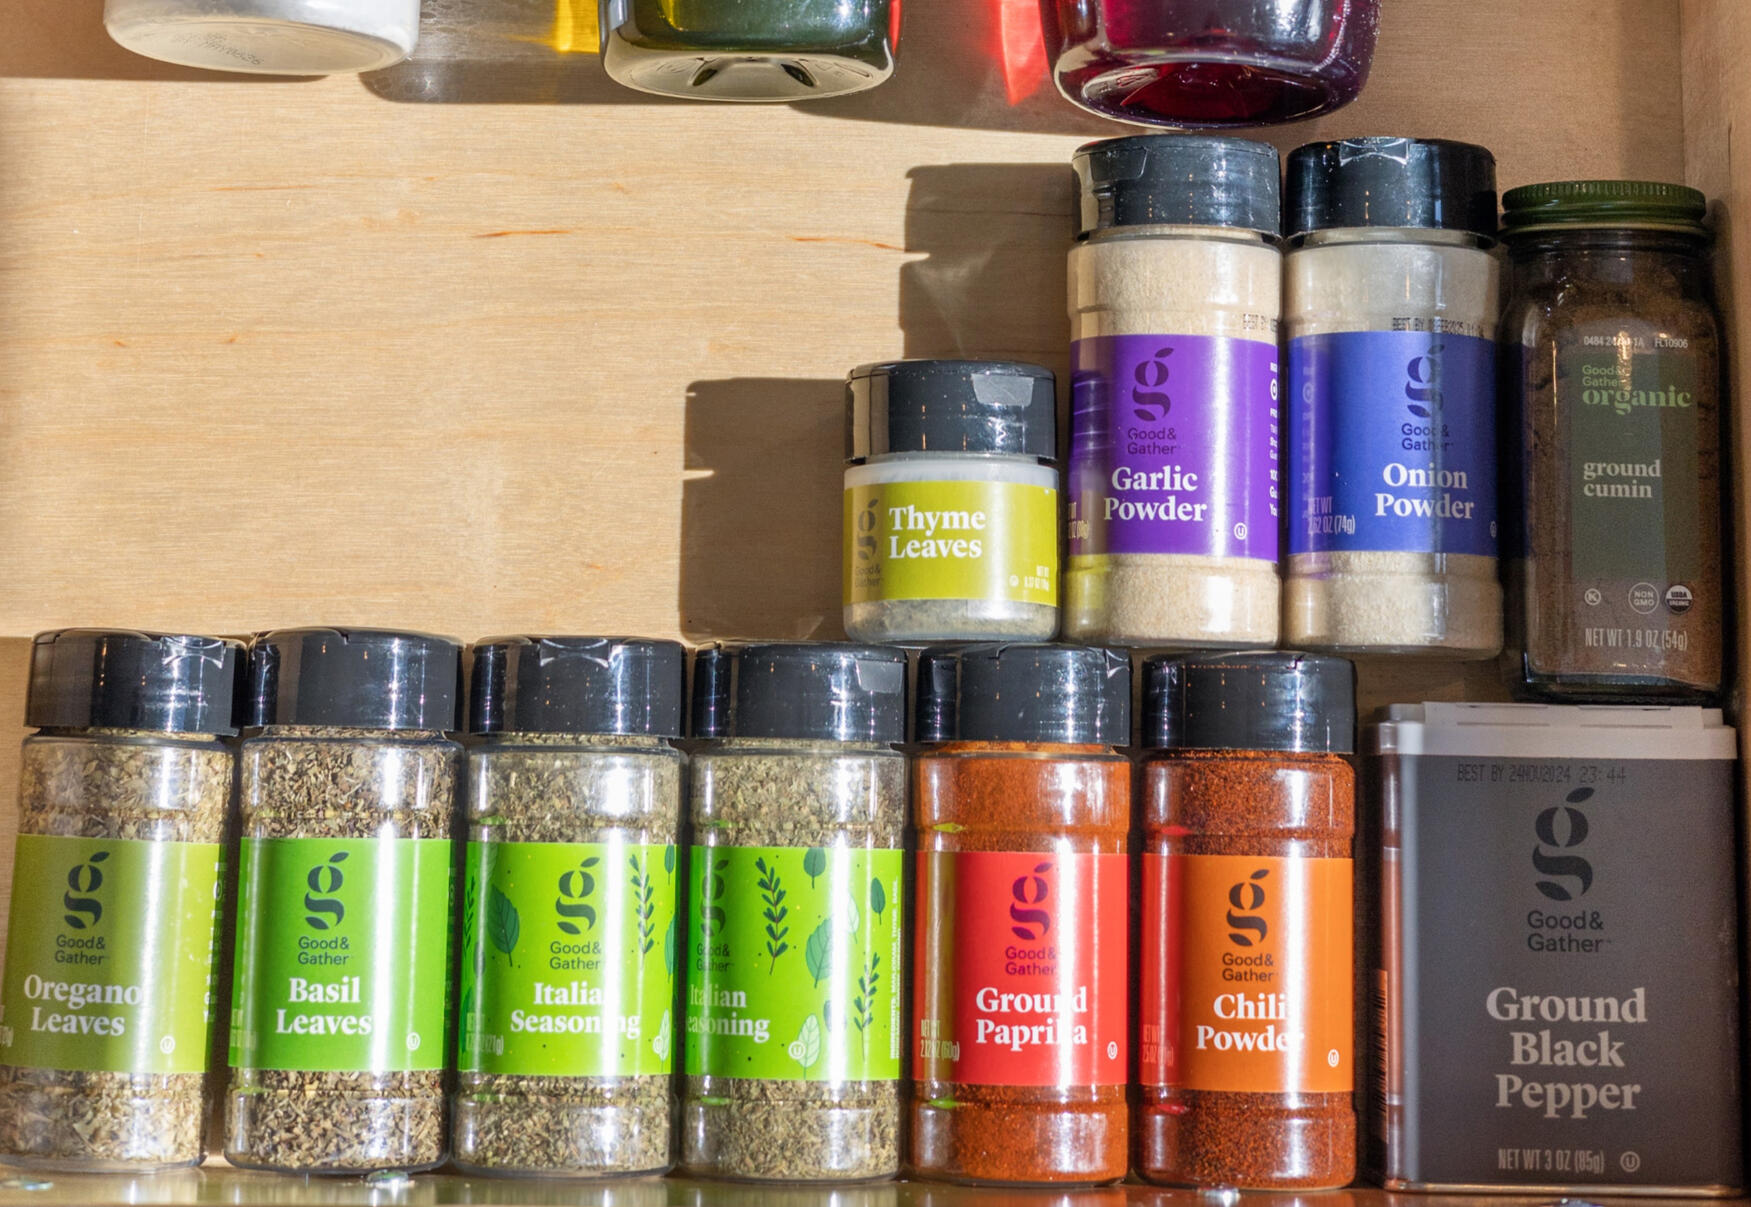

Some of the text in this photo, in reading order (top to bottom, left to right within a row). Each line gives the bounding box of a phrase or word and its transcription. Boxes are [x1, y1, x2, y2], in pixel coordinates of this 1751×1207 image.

[1582, 385, 1691, 415] organic
[1127, 442, 1177, 455] Gather
[1111, 465, 1198, 492] Garlic
[1383, 462, 1468, 488] Onion
[1583, 460, 1661, 480] ground
[1583, 480, 1652, 498] cumin
[1103, 496, 1207, 522] Powder
[1375, 493, 1475, 519] Powder
[889, 505, 986, 536] Thyme
[889, 536, 982, 559] Leaves
[1585, 628, 1688, 651] NET WT 1.9 OZ (54g)
[1456, 764, 1485, 781] BEST
[1491, 764, 1504, 782] BY
[55, 950, 105, 964] Gather
[1527, 934, 1602, 954] Gather
[297, 951, 349, 965] Gather
[549, 956, 600, 970] Gather
[1005, 962, 1056, 976] Gather
[1222, 969, 1274, 982] Gather
[24, 974, 143, 1009] Oregano
[288, 976, 361, 1003] Basil
[533, 981, 604, 1005] Italia
[1213, 993, 1287, 1020] Chili
[1486, 987, 1648, 1024] Ground
[31, 1006, 126, 1036] Leaves
[275, 1008, 372, 1035] Leaves
[510, 1010, 641, 1039] Seasonng
[976, 1019, 1088, 1051] Papria
[1510, 1029, 1625, 1067] Black
[1494, 1073, 1641, 1119] Pepper
[1498, 1148, 1520, 1169] NET
[1522, 1149, 1541, 1170] WT
[1544, 1149, 1552, 1170] 3
[1556, 1150, 1571, 1170] OZ
